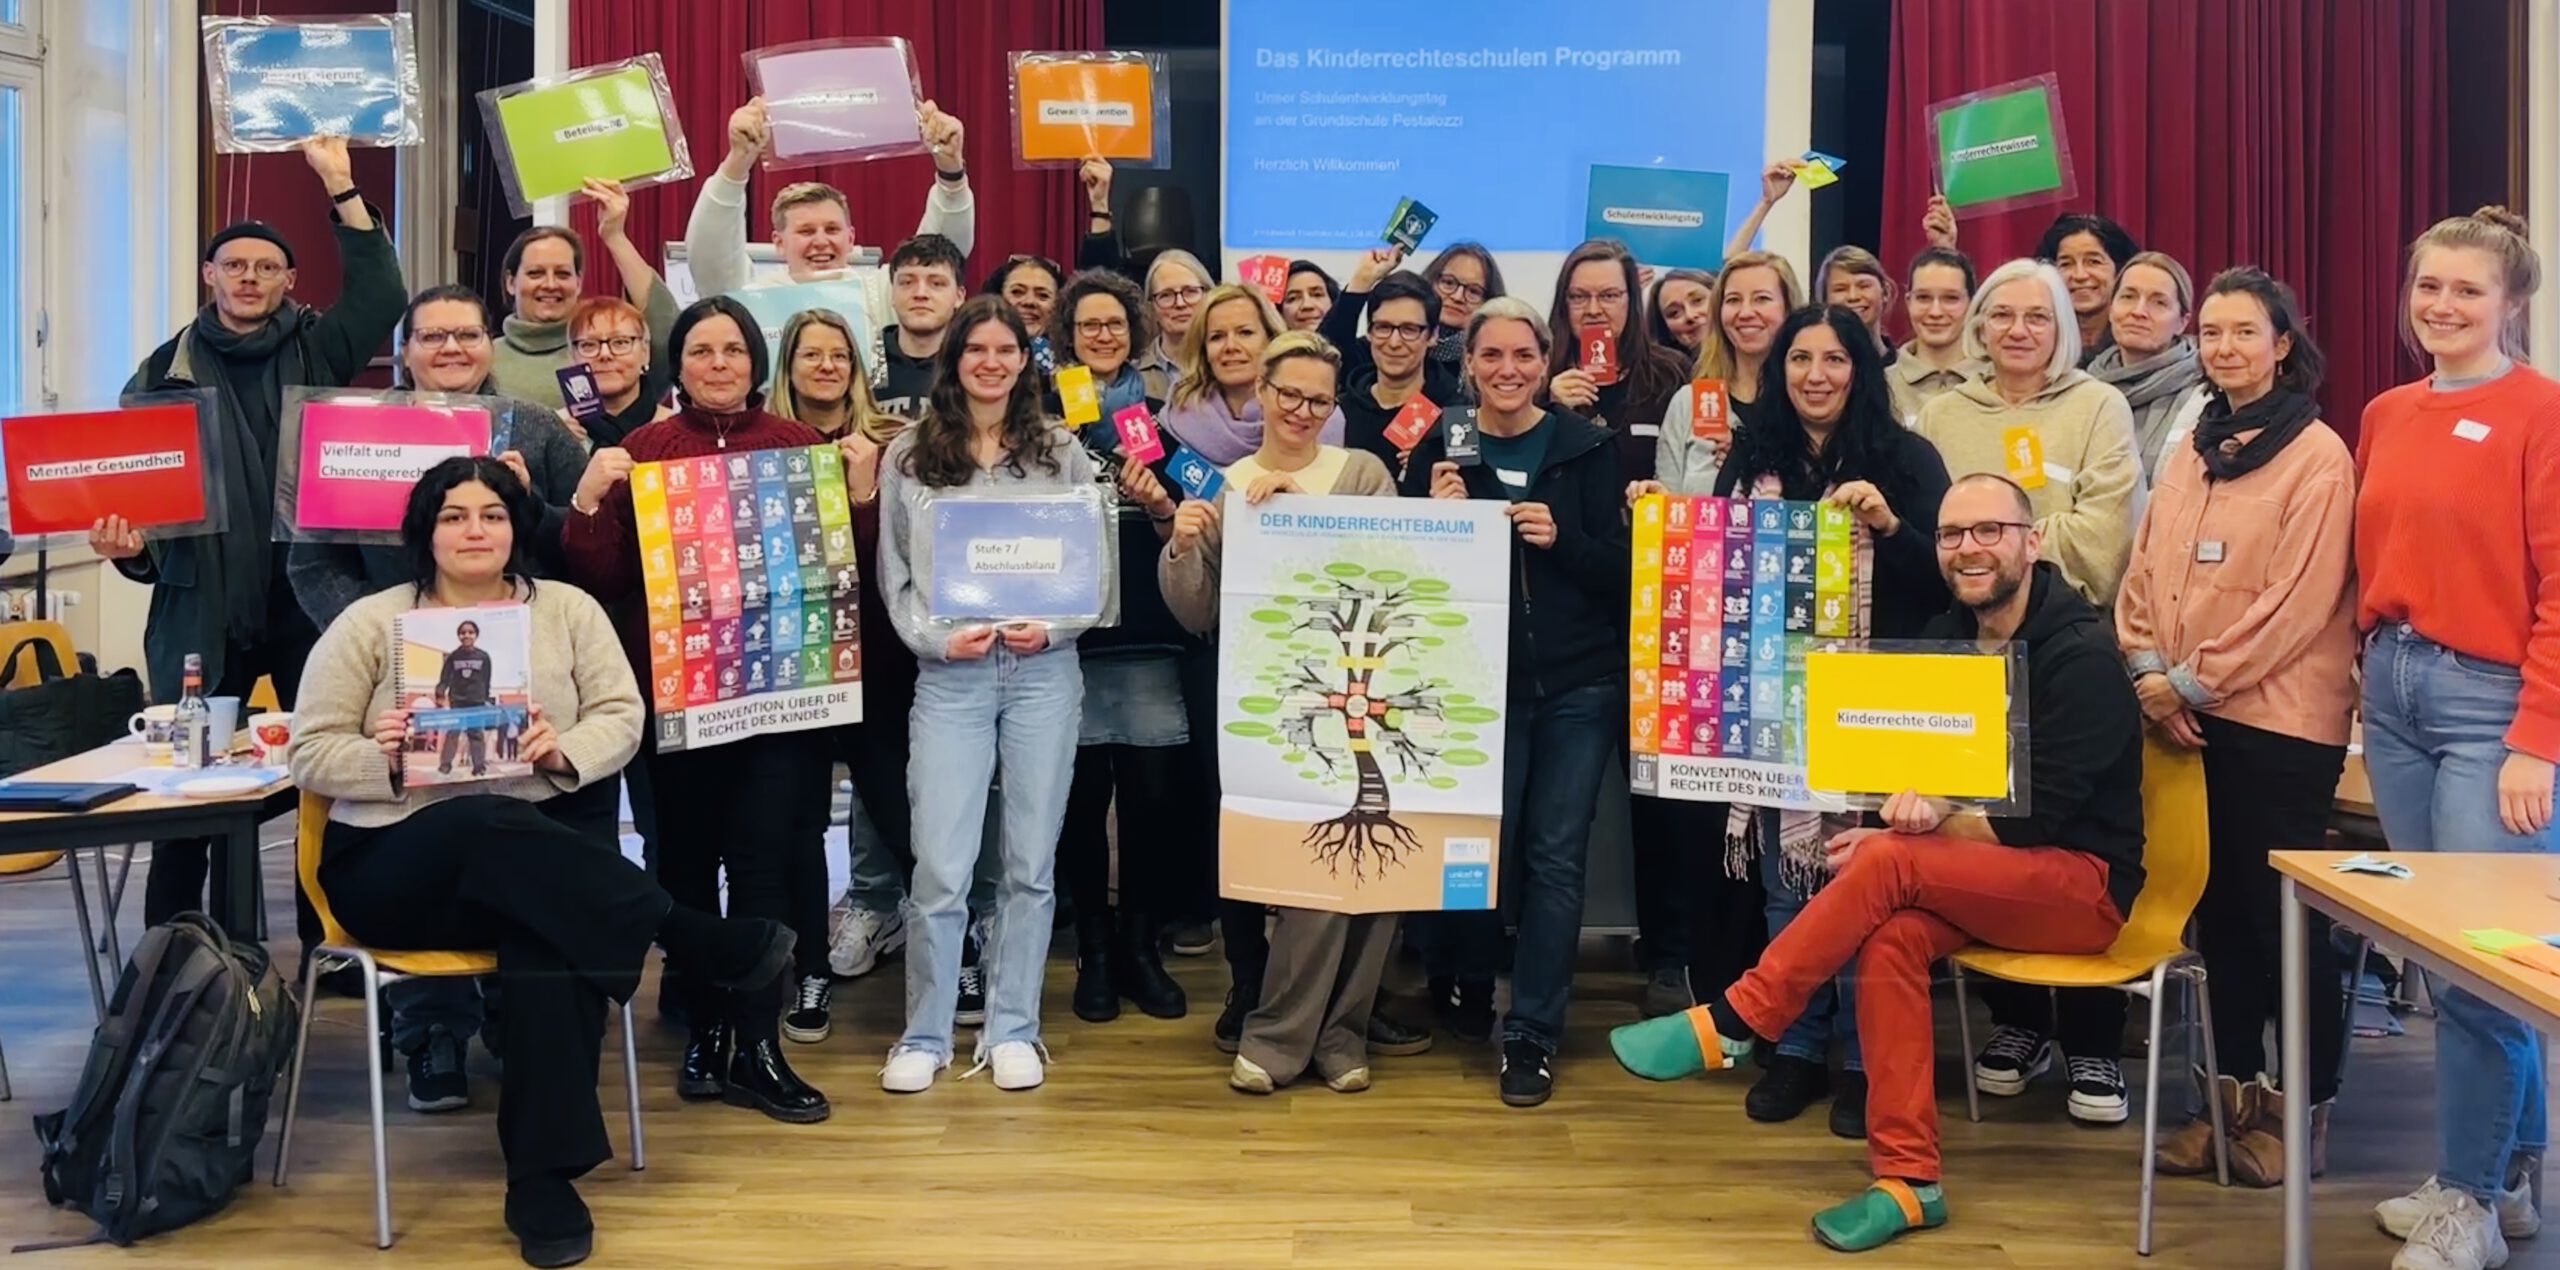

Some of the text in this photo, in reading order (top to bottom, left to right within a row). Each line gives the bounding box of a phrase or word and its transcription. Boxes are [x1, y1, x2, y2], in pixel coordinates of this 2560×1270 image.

[1256, 46, 1681, 70] Das Kinderrechteschulen Programm
[1255, 91, 1448, 107] Unser Schulentwicklungstag
[1254, 114, 1463, 127] an der Grundschule Pestalozzi
[1254, 158, 1400, 171] Herzlich Willkommen!
[1607, 209, 1701, 224] Schulentwicklungstag
[322, 445, 402, 458] Vielfalt und
[29, 453, 183, 478] Mentale Gesundheit
[321, 465, 426, 480] Chancengerech
[1260, 513, 1293, 527] DER
[1297, 514, 1474, 534] KINDERRECHTEBAUM
[975, 543, 1020, 555] Stufe 7 /
[975, 560, 1056, 570] Abschlussbilanz
[698, 699, 784, 724] KONVENTION
[788, 693, 824, 708] ÜBER
[827, 691, 848, 704] DIE
[698, 707, 829, 739] RECHTE DES KINDES
[1837, 711, 1972, 729] Kinderrechte Global
[1670, 763, 1804, 785] KONVENTION ÜBER
[1670, 778, 1811, 801] RECHTE DES KINDES
